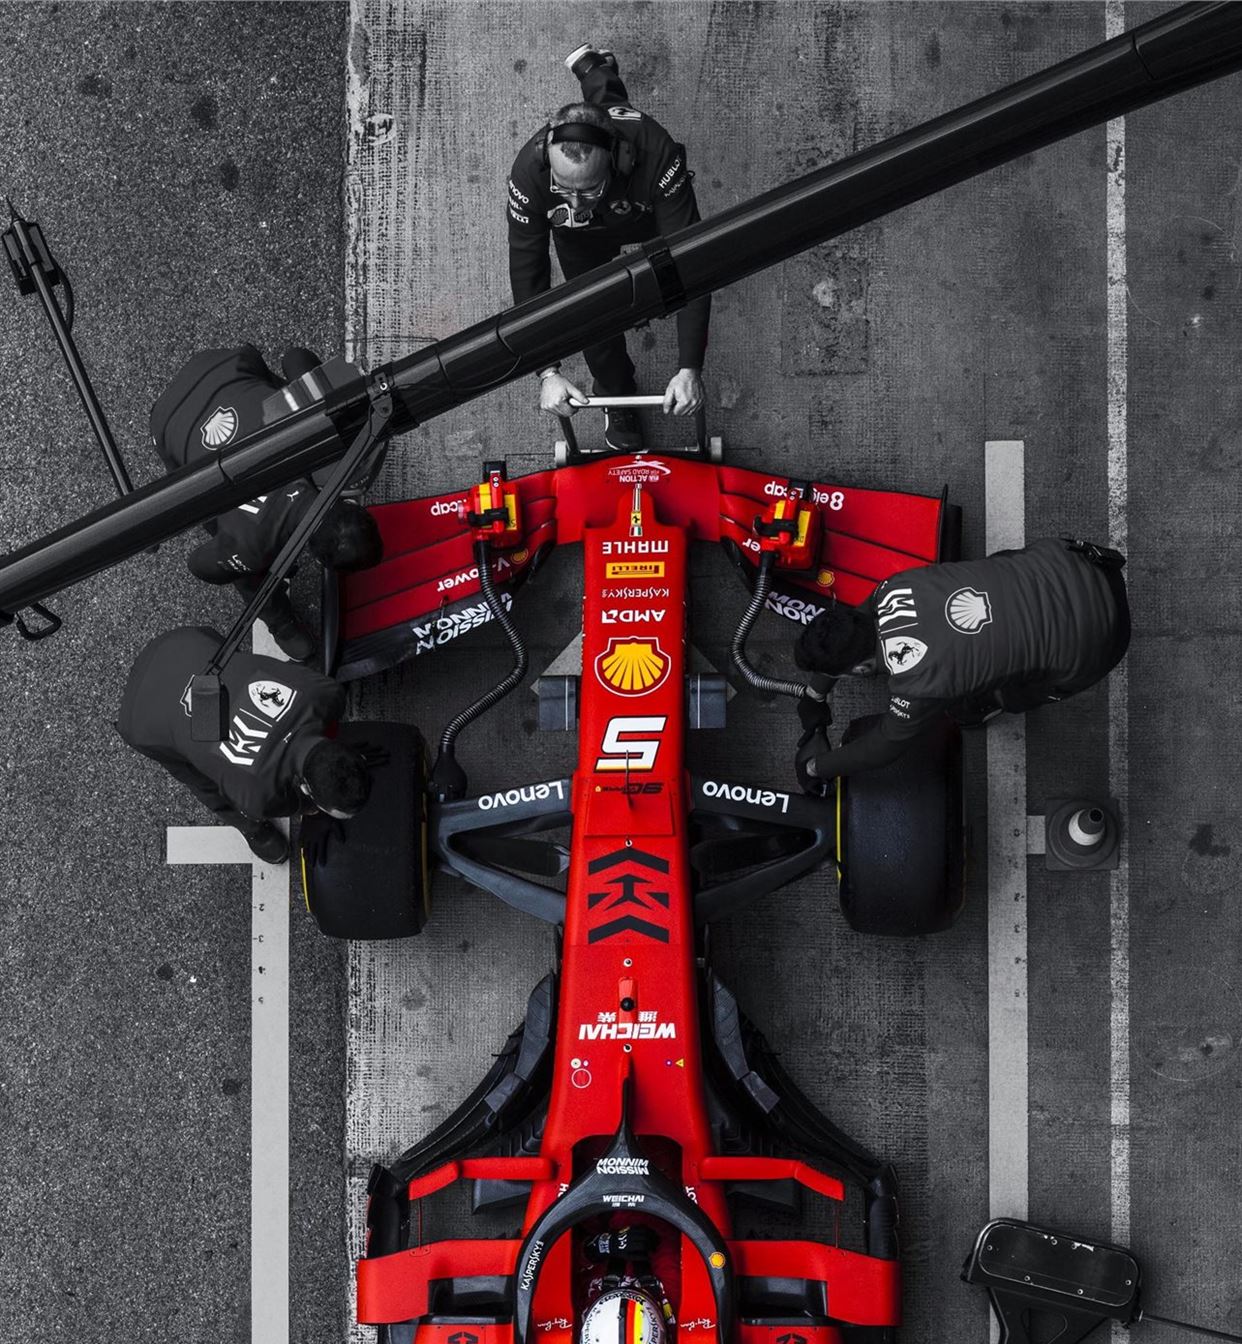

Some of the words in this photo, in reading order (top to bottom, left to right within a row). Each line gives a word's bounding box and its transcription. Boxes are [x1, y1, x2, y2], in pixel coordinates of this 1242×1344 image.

[619, 474, 648, 483] ACTION
[602, 540, 669, 555] MAHLE
[611, 564, 660, 575] PIRELLI
[608, 586, 670, 600] KASPERSKY
[618, 609, 667, 623] AMD
[415, 600, 513, 656] ISSION
[596, 714, 669, 773] 5
[477, 779, 564, 811] Lenovo
[702, 780, 789, 813] Lenovo
[578, 1022, 677, 1041] WEICHAI
[596, 1157, 650, 1167] WINNOW
[596, 1165, 650, 1176] MISSION
[602, 1194, 645, 1203] WEICHAI
[520, 1247, 543, 1291] KASPERSKY
[537, 1317, 573, 1331] Ray-Ban
[680, 1317, 716, 1331] Ray-Ban
